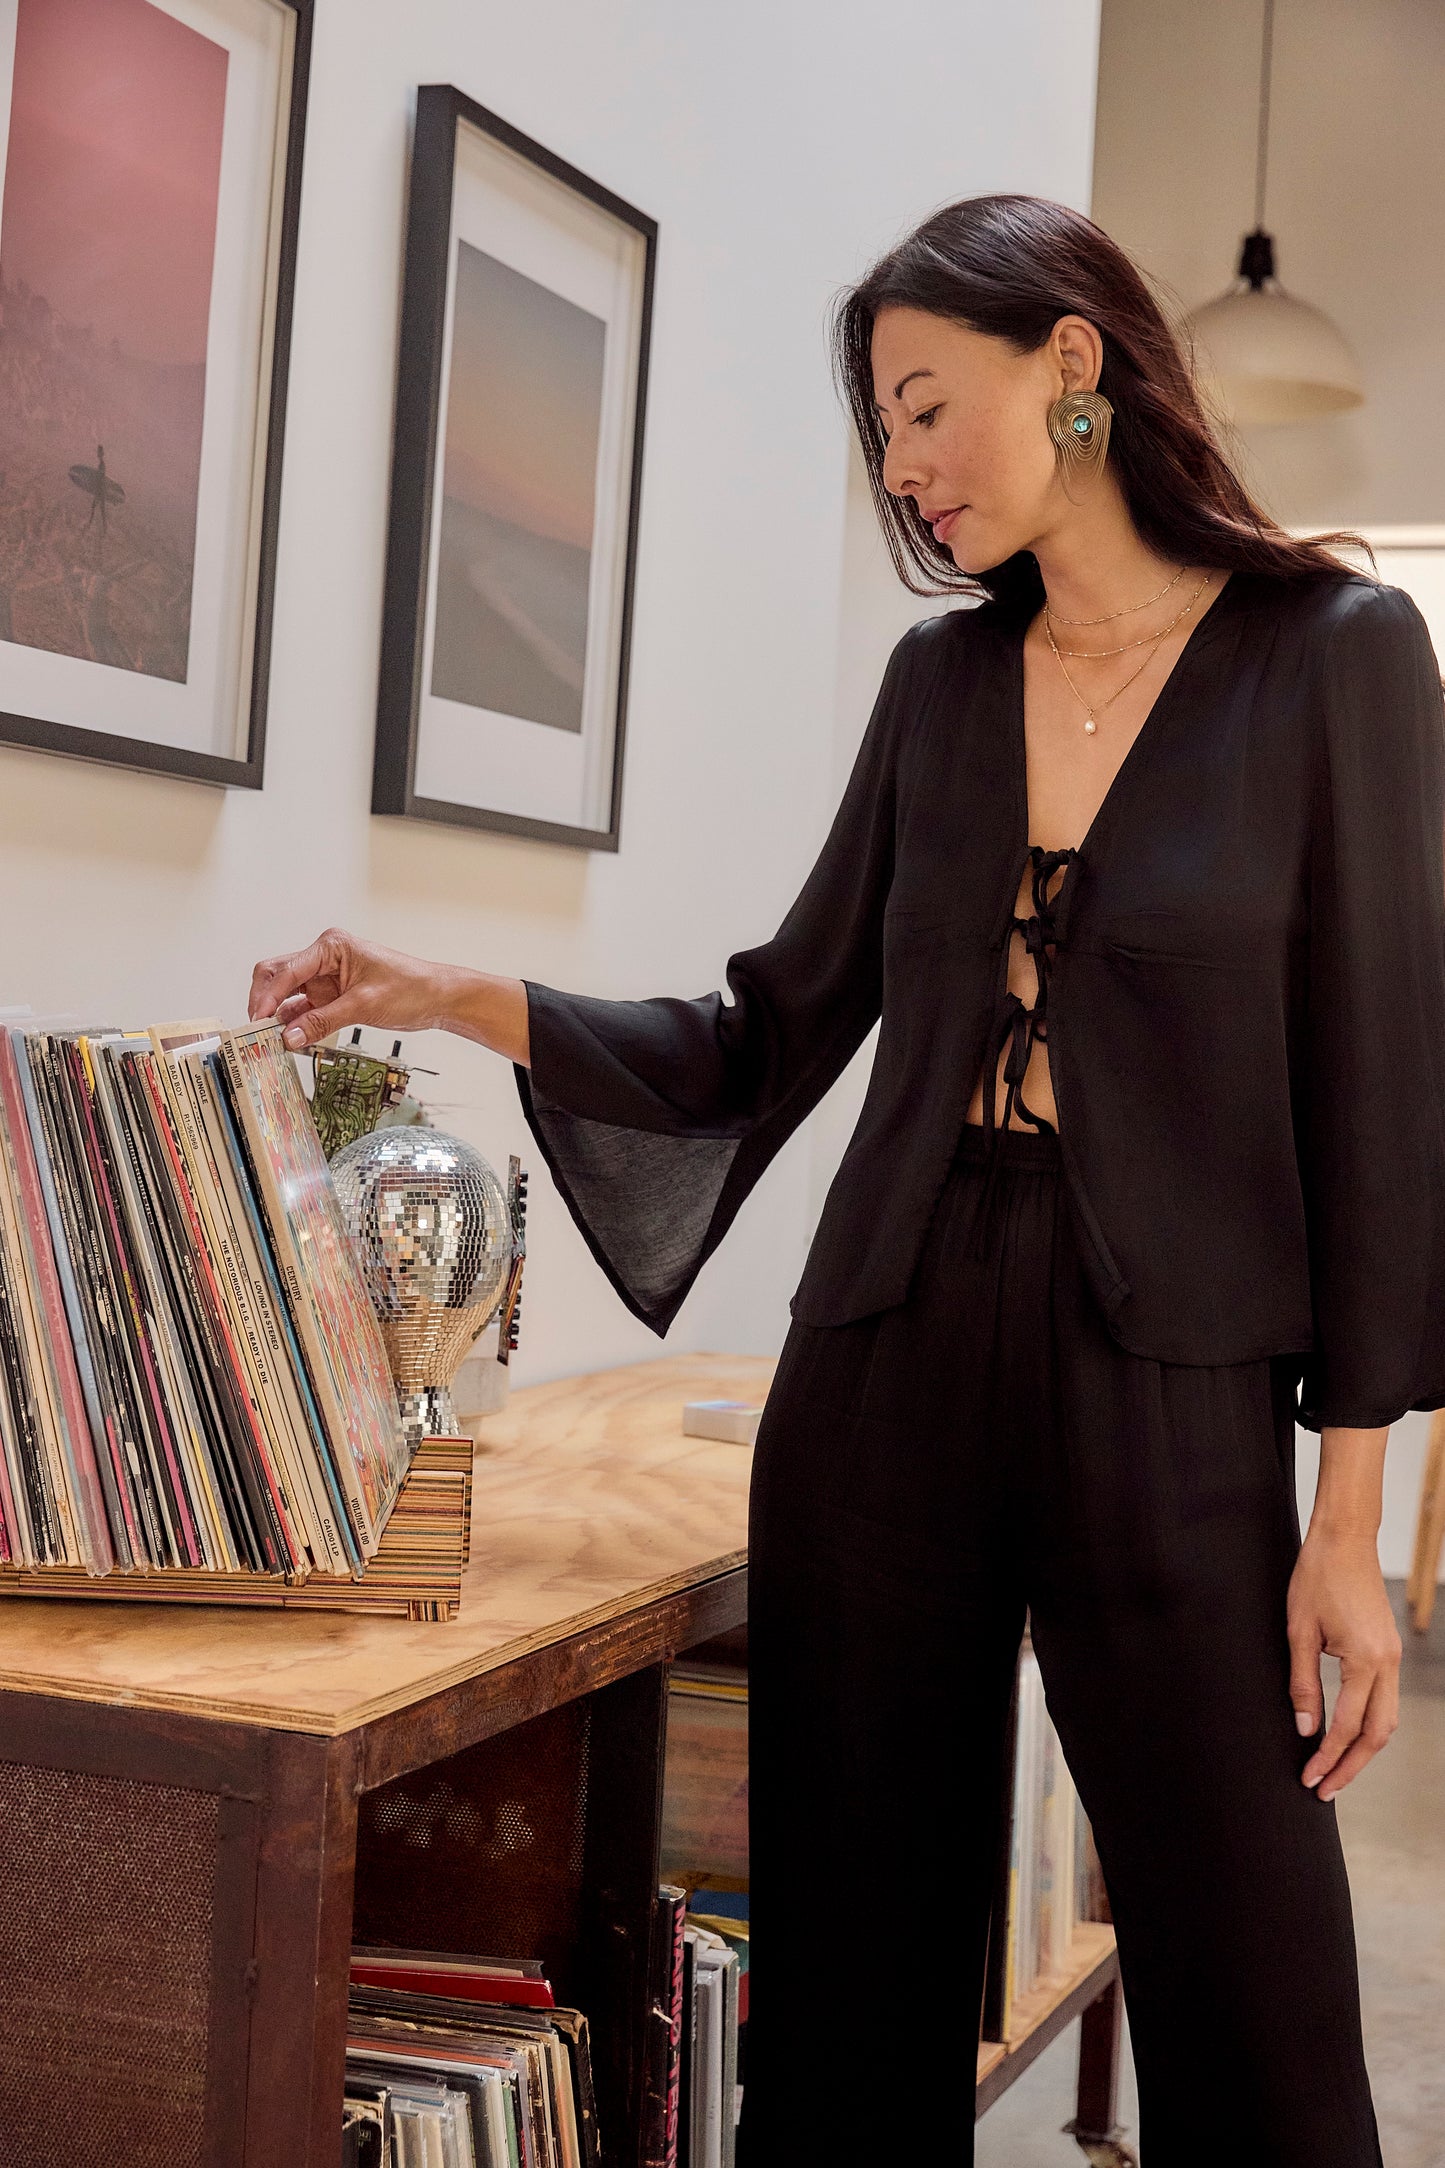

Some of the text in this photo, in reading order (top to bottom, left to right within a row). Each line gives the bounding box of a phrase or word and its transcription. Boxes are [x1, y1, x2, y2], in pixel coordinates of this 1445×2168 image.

[169, 1064, 183, 1097] BAD BOY
[222, 1040, 236, 1064] VINYL
[229, 1065, 243, 1089] MOON
[194, 1072, 208, 1104] JUNGLE
[43, 1128, 54, 1158] VANDROSS
[183, 1113, 198, 1150] R1-562969
[220, 1239, 230, 1254] THE
[94, 1256, 103, 1275] DREAM
[225, 1256, 243, 1301] NOTORIOUS
[285, 1265, 302, 1302] CENTURY
[147, 1268, 161, 1307] BROCKHAMPTON
[239, 1303, 250, 1324] B.I.G.
[253, 1280, 279, 1350] LOVING IN STEREO
[247, 1331, 260, 1356] READY
[256, 1359, 264, 1369] TO
[259, 1371, 268, 1384] DIE
[265, 1488, 275, 1510] WARNER
[276, 1526, 286, 1550] RECORDS
[322, 1518, 339, 1556] CAI001LP
[349, 1497, 370, 1545] VOLUME 100
[670, 1904, 685, 2046] MARIO
